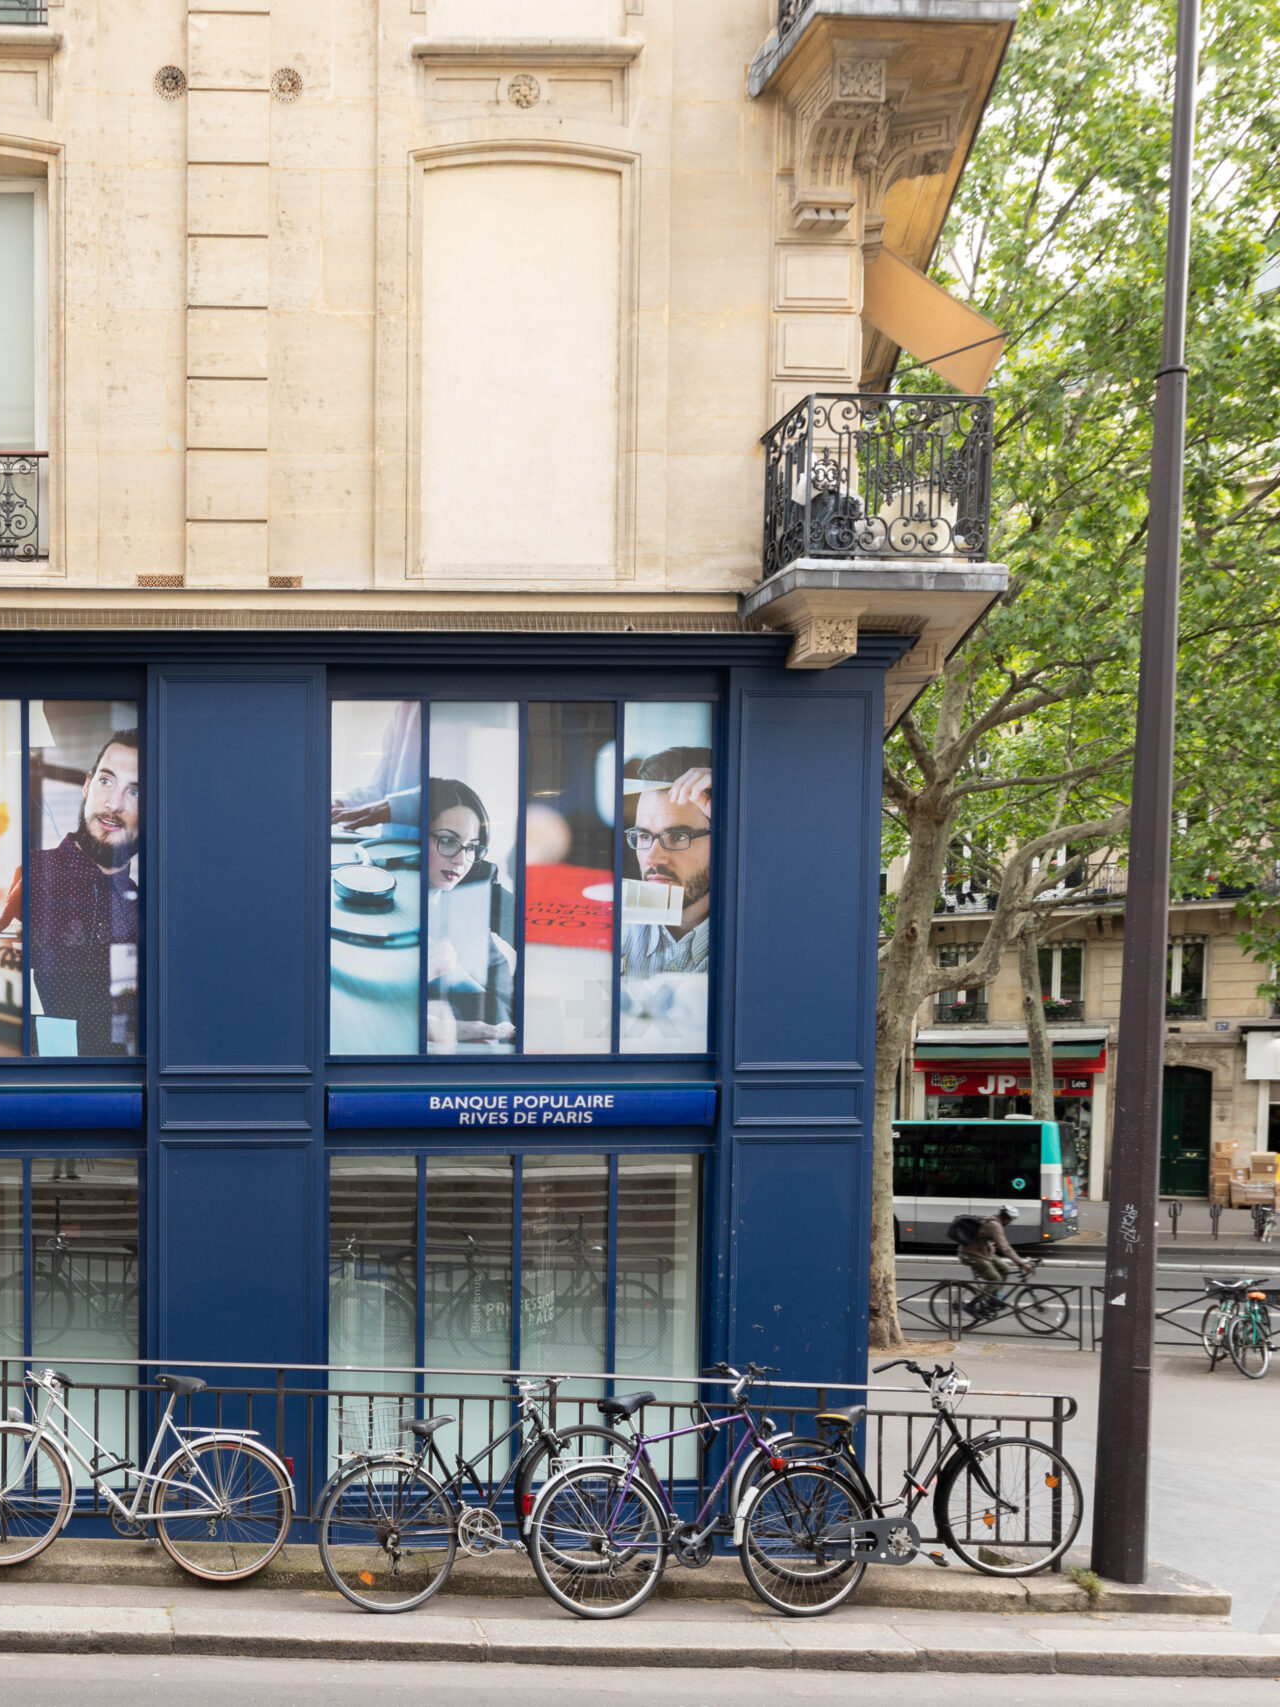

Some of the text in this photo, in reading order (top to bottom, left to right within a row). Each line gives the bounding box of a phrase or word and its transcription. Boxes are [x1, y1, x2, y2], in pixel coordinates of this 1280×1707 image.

[525, 918, 611, 930] COD
[977, 1075, 1016, 1095] JP
[1071, 1080, 1087, 1088] Lee
[429, 1095, 614, 1110] BANQUE POPULAIRE
[459, 1111, 593, 1125] RIVES DE PARIS
